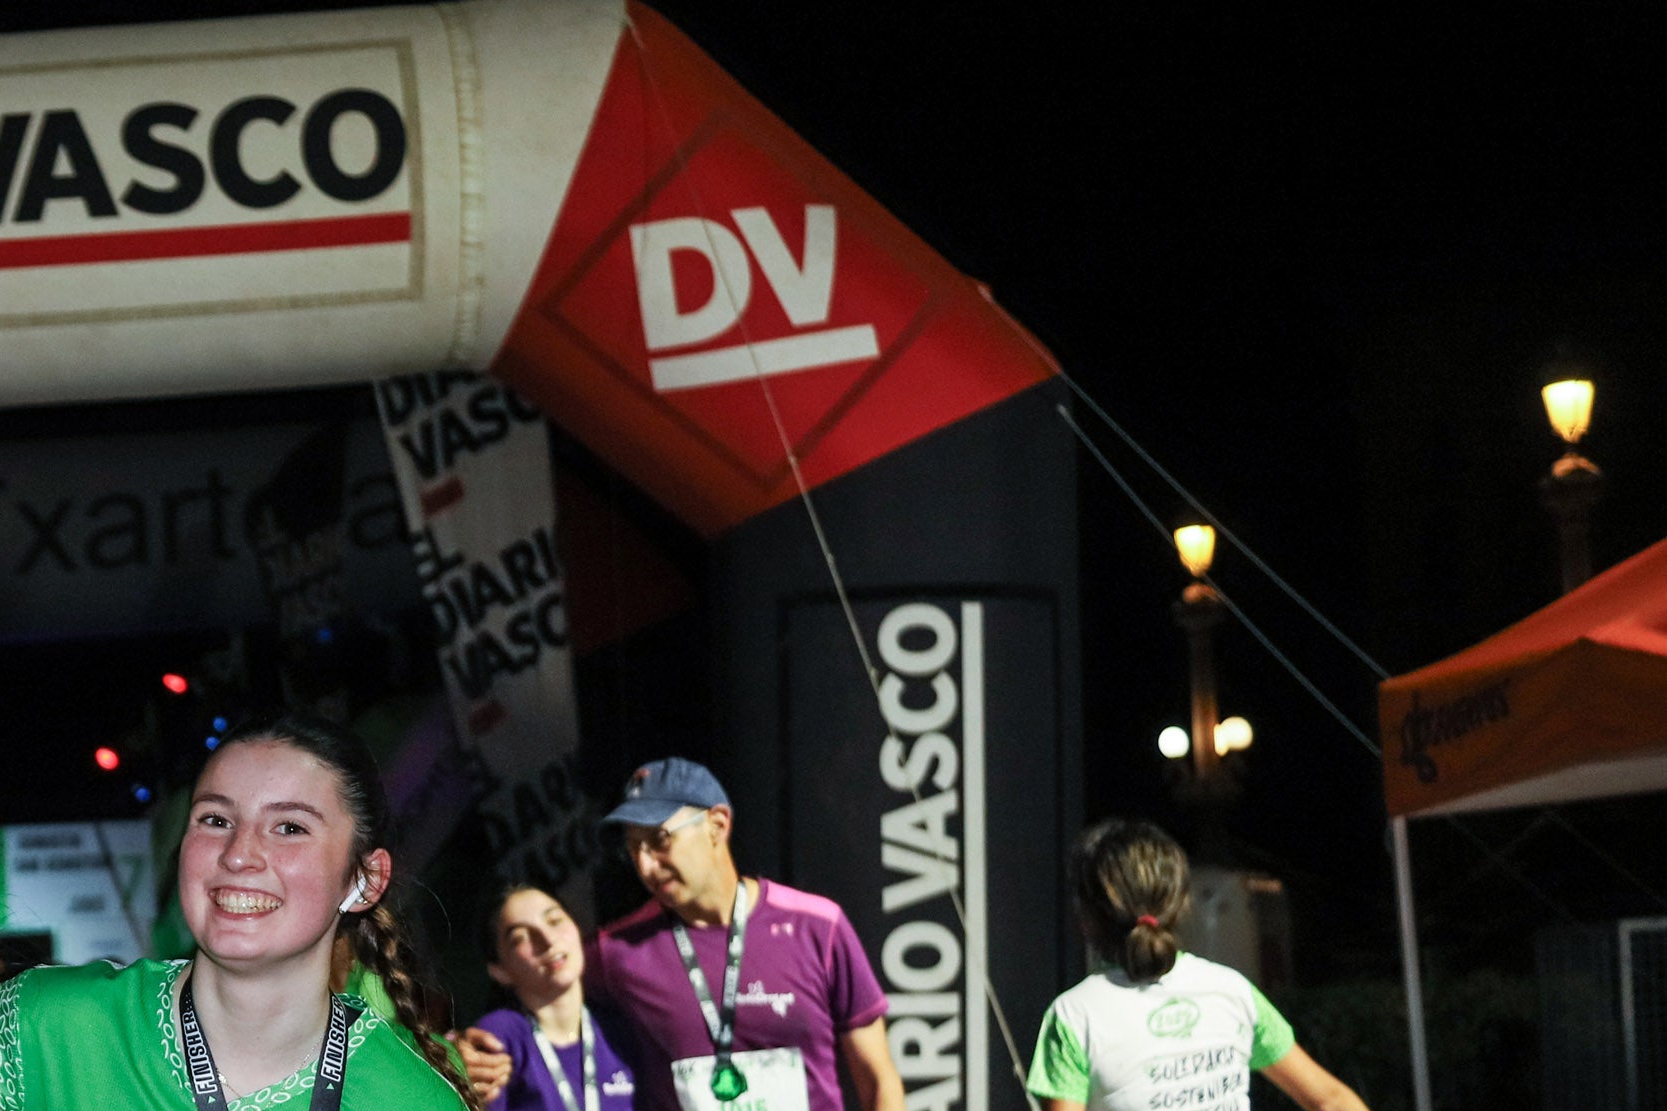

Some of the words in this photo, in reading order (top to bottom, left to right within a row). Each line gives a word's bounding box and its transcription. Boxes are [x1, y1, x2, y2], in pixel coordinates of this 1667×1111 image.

[629, 204, 838, 351] DV
[877, 602, 961, 912] VASCO
[181, 1009, 218, 1095] FINISHER
